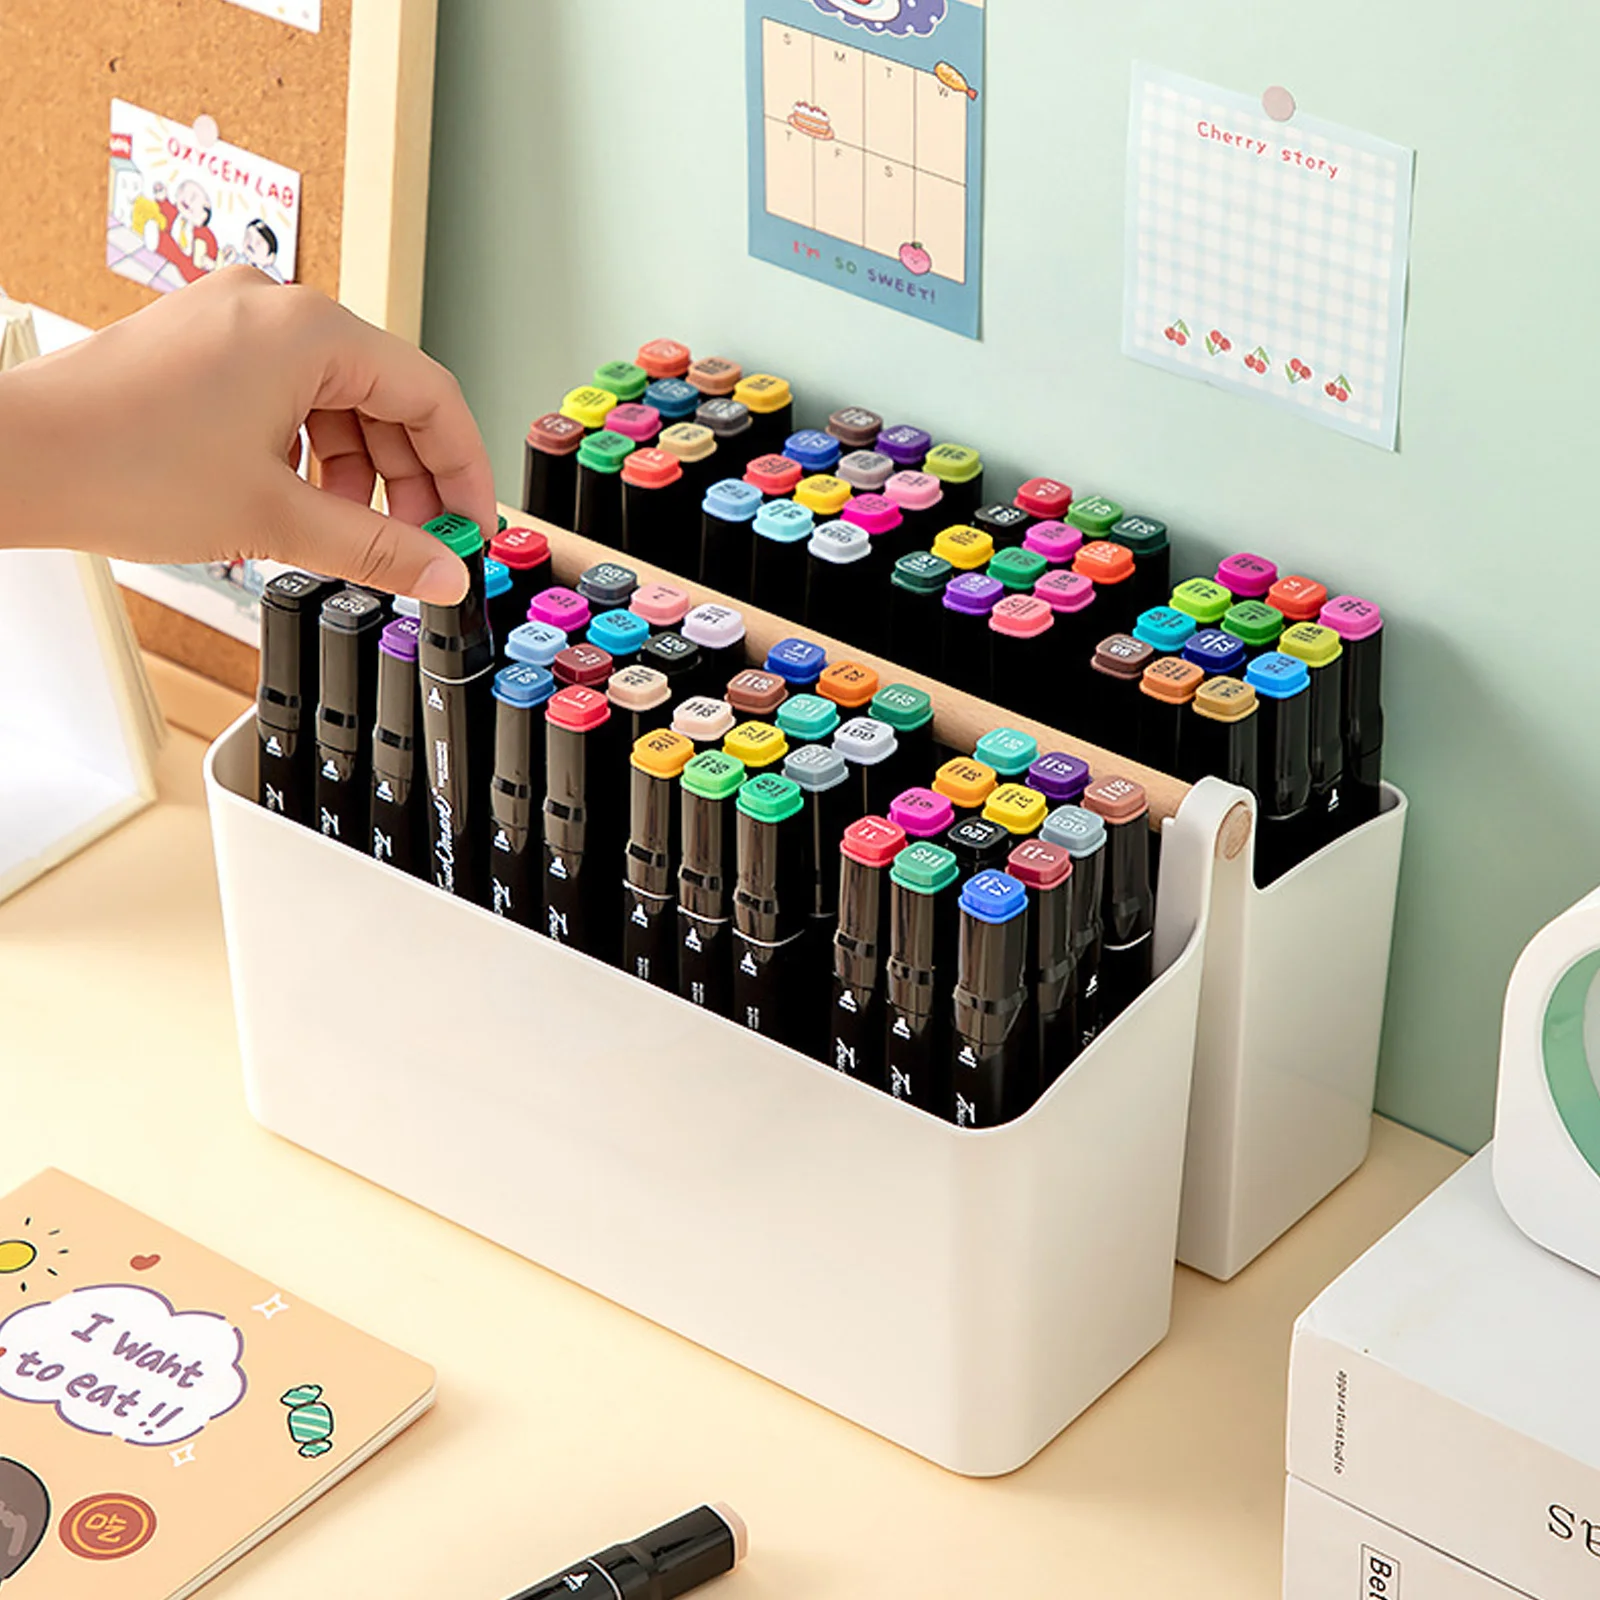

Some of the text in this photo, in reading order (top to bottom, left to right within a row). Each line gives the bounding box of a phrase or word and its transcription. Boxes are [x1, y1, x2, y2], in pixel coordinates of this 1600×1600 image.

[783, 33, 791, 46] S
[834, 51, 846, 63] M
[885, 67, 892, 79] T
[785, 130, 893, 178] T F S
[1197, 121, 1339, 179] Cherry story
[255, 176, 294, 208] LAB
[835, 256, 857, 275] SO
[867, 268, 935, 304] SWEET!
[71, 1313, 114, 1343] I
[16, 1351, 65, 1382] to
